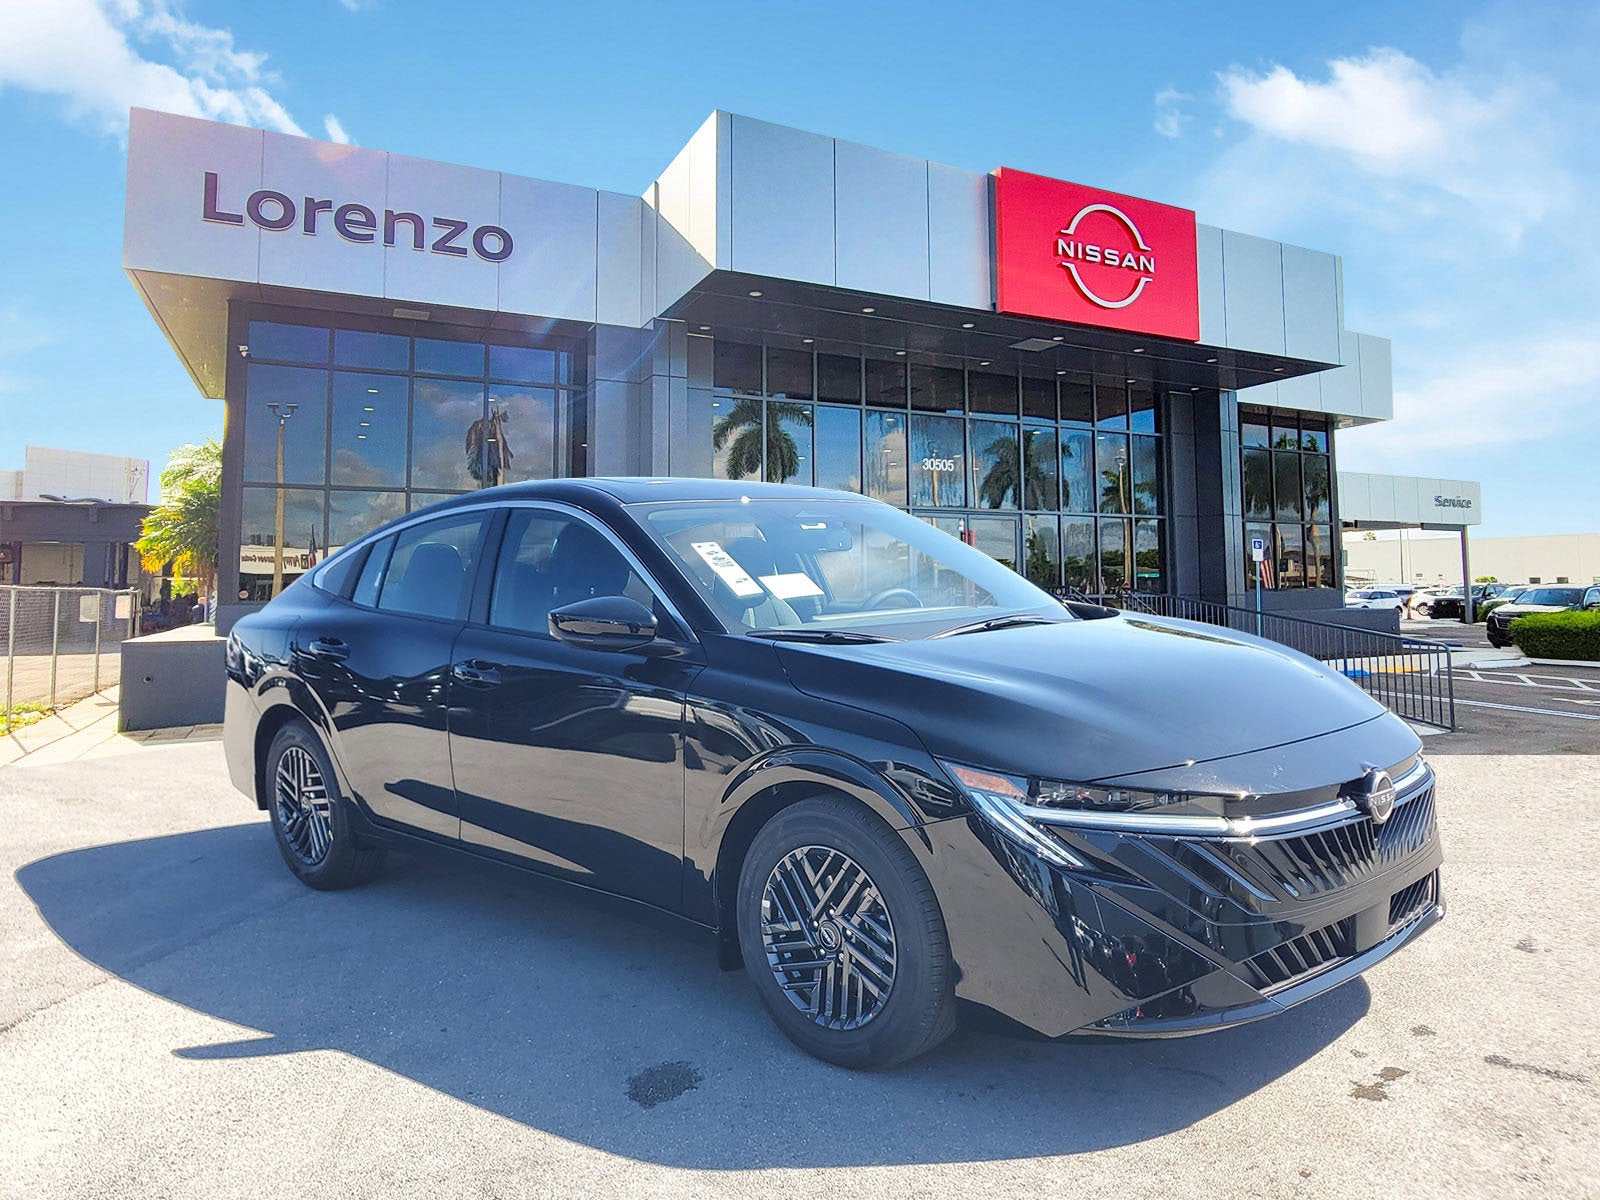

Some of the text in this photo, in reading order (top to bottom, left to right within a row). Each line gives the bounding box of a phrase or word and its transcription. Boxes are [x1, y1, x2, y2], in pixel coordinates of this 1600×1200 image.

[202, 170, 514, 263] Lorenzo
[1057, 238, 1155, 273] NISSAN
[922, 458, 955, 471] 30505
[1434, 495, 1472, 509] Service
